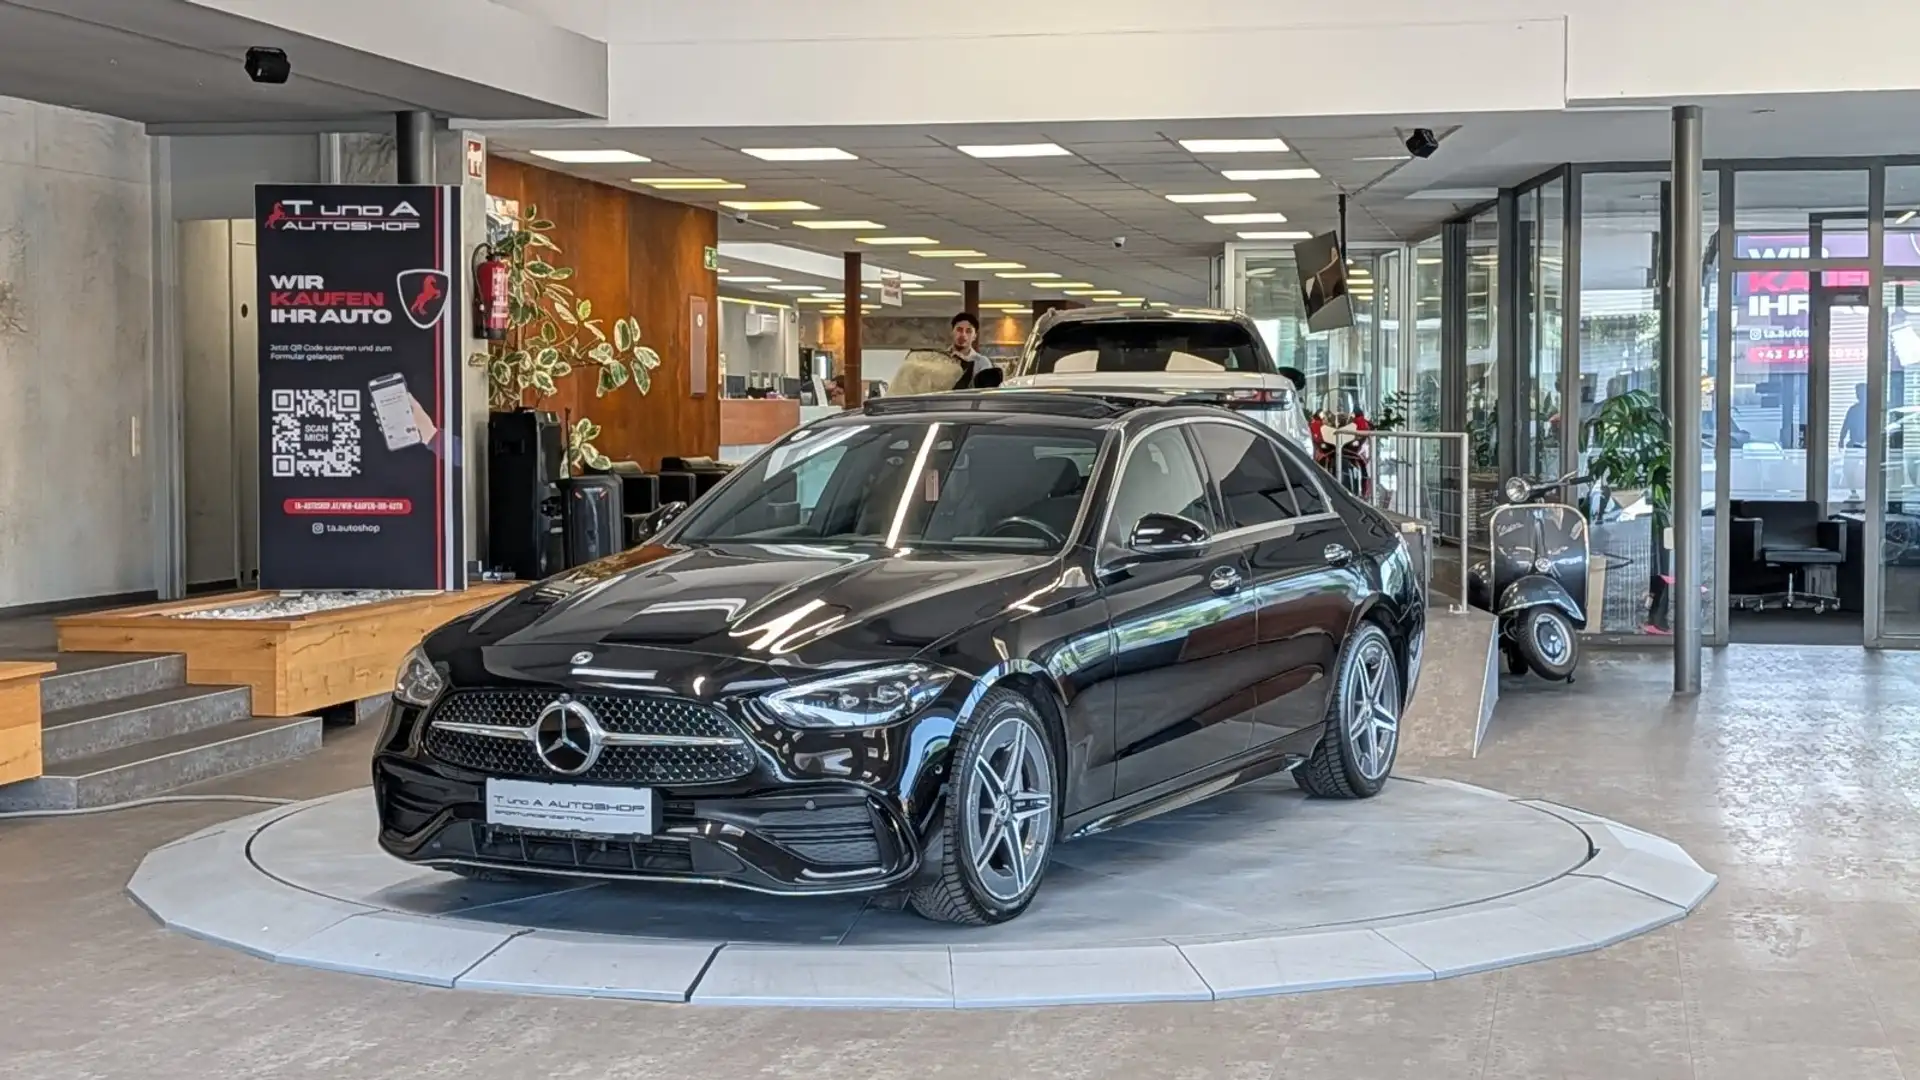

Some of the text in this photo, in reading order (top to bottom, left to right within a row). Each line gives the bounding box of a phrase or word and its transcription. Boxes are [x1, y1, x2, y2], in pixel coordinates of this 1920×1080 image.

[282, 200, 313, 216] T
[389, 201, 420, 217] A
[282, 221, 420, 232] AUTOSHOP
[269, 275, 324, 290] WIR
[270, 292, 384, 306] KAUFEN
[270, 309, 392, 324] IHR AUTO
[270, 344, 288, 352] Jetzt
[290, 344, 303, 353] QR
[303, 344, 323, 352] Code
[325, 344, 357, 352] scannen
[358, 344, 373, 352] und
[304, 425, 329, 433] SCAN
[304, 433, 329, 442] MICH
[327, 524, 380, 533] ta.autoshop
[493, 795, 504, 804] T
[533, 799, 543, 807] A
[548, 800, 645, 812] AUTOSHOP
